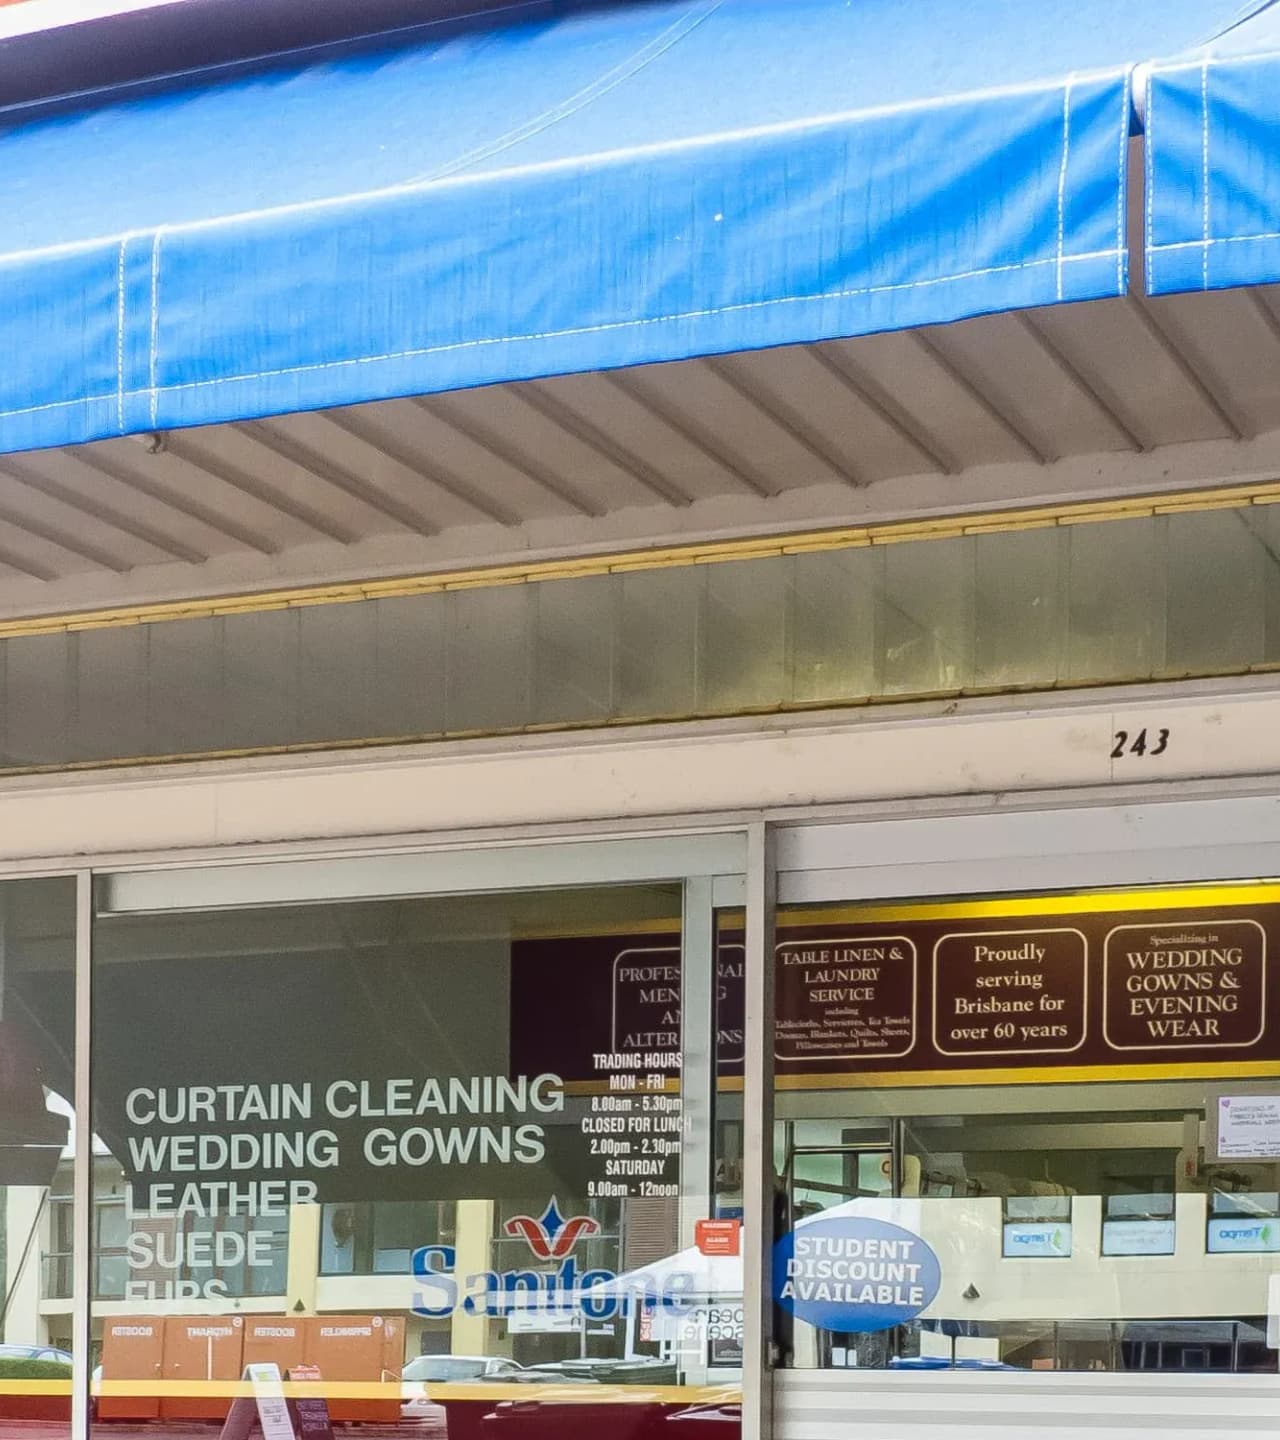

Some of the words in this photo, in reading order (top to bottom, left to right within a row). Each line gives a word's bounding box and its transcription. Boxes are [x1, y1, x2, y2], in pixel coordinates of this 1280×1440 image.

[1110, 728, 1170, 758] 243
[781, 951, 830, 965] TABLE
[834, 947, 885, 963] LINEN
[889, 947, 904, 960] &
[974, 943, 1045, 963] Proudly
[1126, 948, 1243, 969] WEDDING
[805, 968, 880, 983] LAUNDRY
[976, 970, 1043, 989] serving
[1126, 972, 1213, 993] GOWNS
[1220, 971, 1241, 989] &
[809, 987, 875, 1002] SERVICE
[954, 996, 1034, 1014] Brisbane
[1039, 994, 1065, 1011] for
[1130, 995, 1238, 1016] EVENING
[951, 1028, 989, 1040] over
[993, 1023, 1015, 1038] 60
[1020, 1024, 1067, 1041] years
[1147, 1019, 1220, 1038] WEAR
[593, 1053, 641, 1069] TRADING
[644, 1052, 682, 1068] HOURS
[609, 1075, 635, 1090] MON
[647, 1074, 665, 1089] FRI
[125, 1083, 312, 1125] CURTAIN
[325, 1073, 565, 1118] CLEANING
[591, 1096, 631, 1112] 8.00am
[642, 1096, 682, 1114] 5.30pm
[581, 1117, 625, 1133] CLOSED
[628, 1117, 651, 1133] FOR
[654, 1117, 692, 1132] LUNCH
[128, 1129, 339, 1173] WEDDING
[364, 1124, 546, 1167] GOWNS
[590, 1139, 631, 1157] 2.00pm
[641, 1138, 682, 1157] 2.30pm
[606, 1160, 665, 1175] SATURDAY
[588, 1181, 628, 1197] 9.00am
[639, 1182, 678, 1197] 12noon
[125, 1180, 319, 1219] LEATHER
[125, 1230, 274, 1269] SUEDE
[796, 1237, 914, 1260] STUDENT
[787, 1258, 922, 1283] DISCOUNT
[780, 1281, 924, 1306] AVAILABLE
